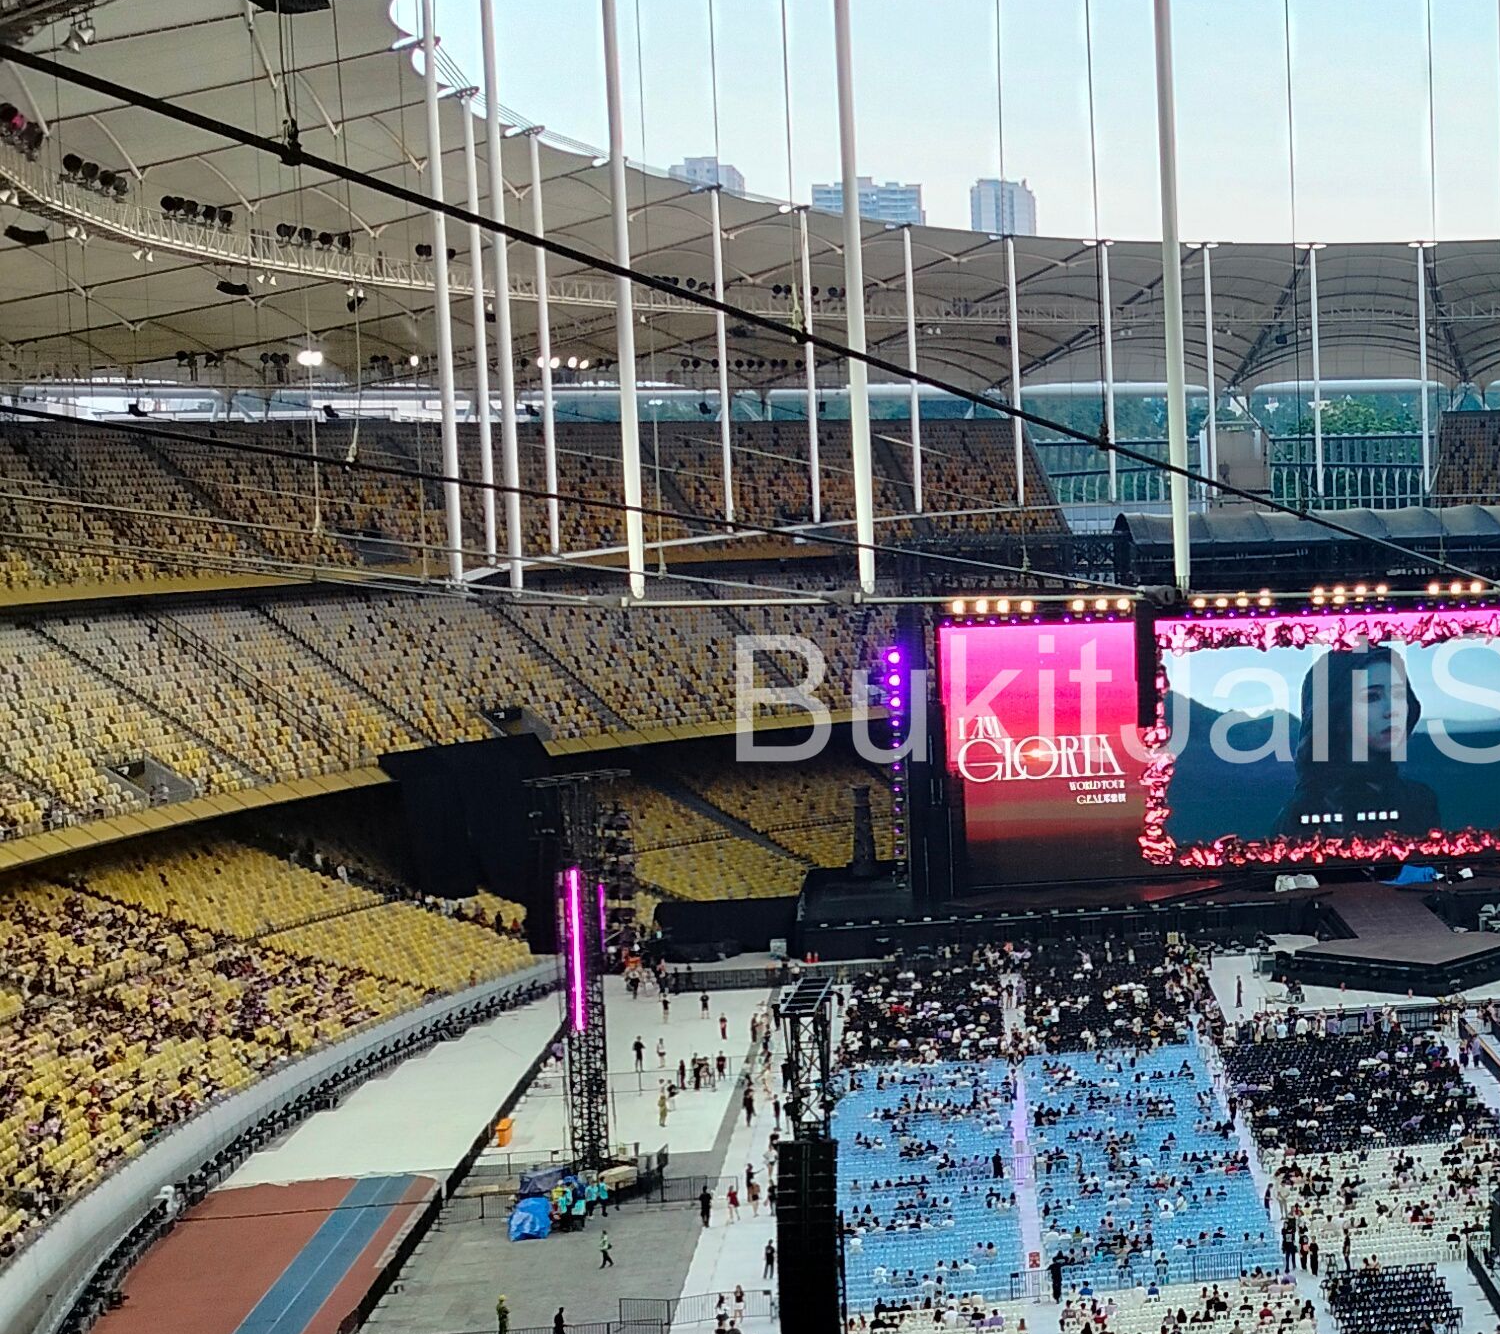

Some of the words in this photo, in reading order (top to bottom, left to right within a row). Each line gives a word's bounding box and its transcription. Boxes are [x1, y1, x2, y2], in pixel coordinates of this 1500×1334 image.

[958, 717, 966, 740] I
[971, 716, 1003, 740] AM
[958, 734, 1127, 783] GLORIA
[1069, 780, 1101, 790] WORLD
